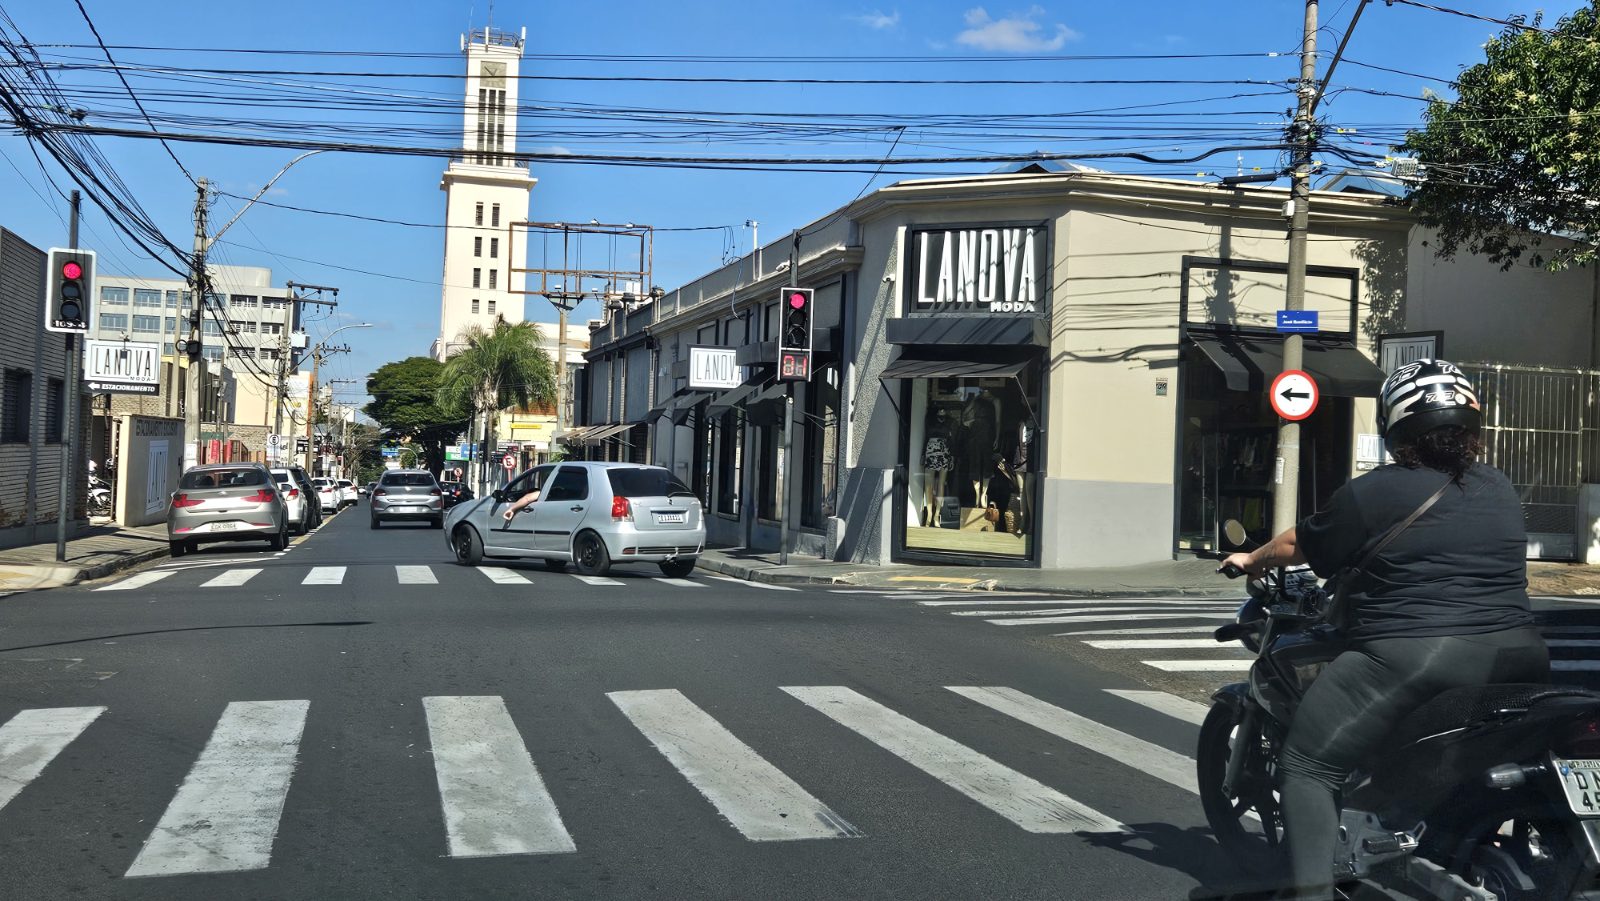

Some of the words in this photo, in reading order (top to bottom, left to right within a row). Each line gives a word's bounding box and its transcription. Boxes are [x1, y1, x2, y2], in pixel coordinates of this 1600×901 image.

[918, 228, 1036, 303] LANOVA
[990, 301, 1035, 313] MODA
[95, 347, 151, 377] LANOVA
[101, 383, 156, 392] ESTACIONAMENTO
